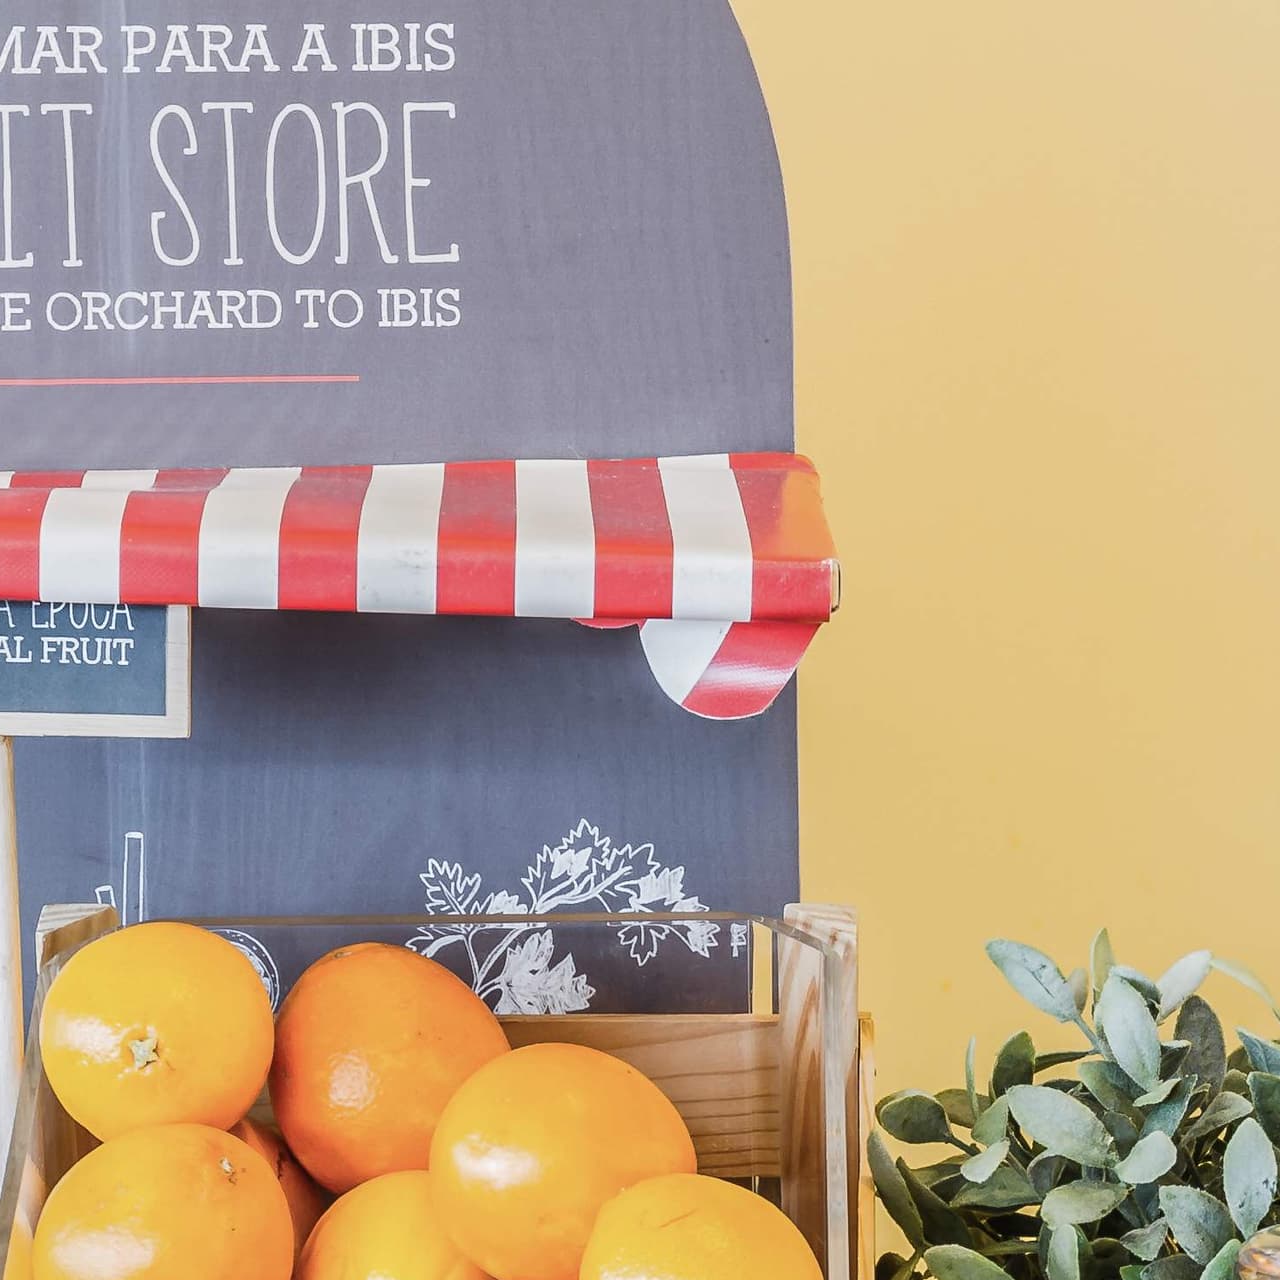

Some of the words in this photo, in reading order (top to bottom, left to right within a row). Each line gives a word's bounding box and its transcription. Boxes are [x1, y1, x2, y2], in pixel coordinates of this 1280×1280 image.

[120, 24, 281, 74] PARA
[291, 23, 338, 72] A
[350, 22, 456, 72] IBIS
[149, 101, 460, 266] STORE
[45, 289, 283, 331] ORCHARD
[295, 289, 364, 329] TO
[376, 287, 461, 328] IBIS
[40, 636, 134, 666] FRUIT
